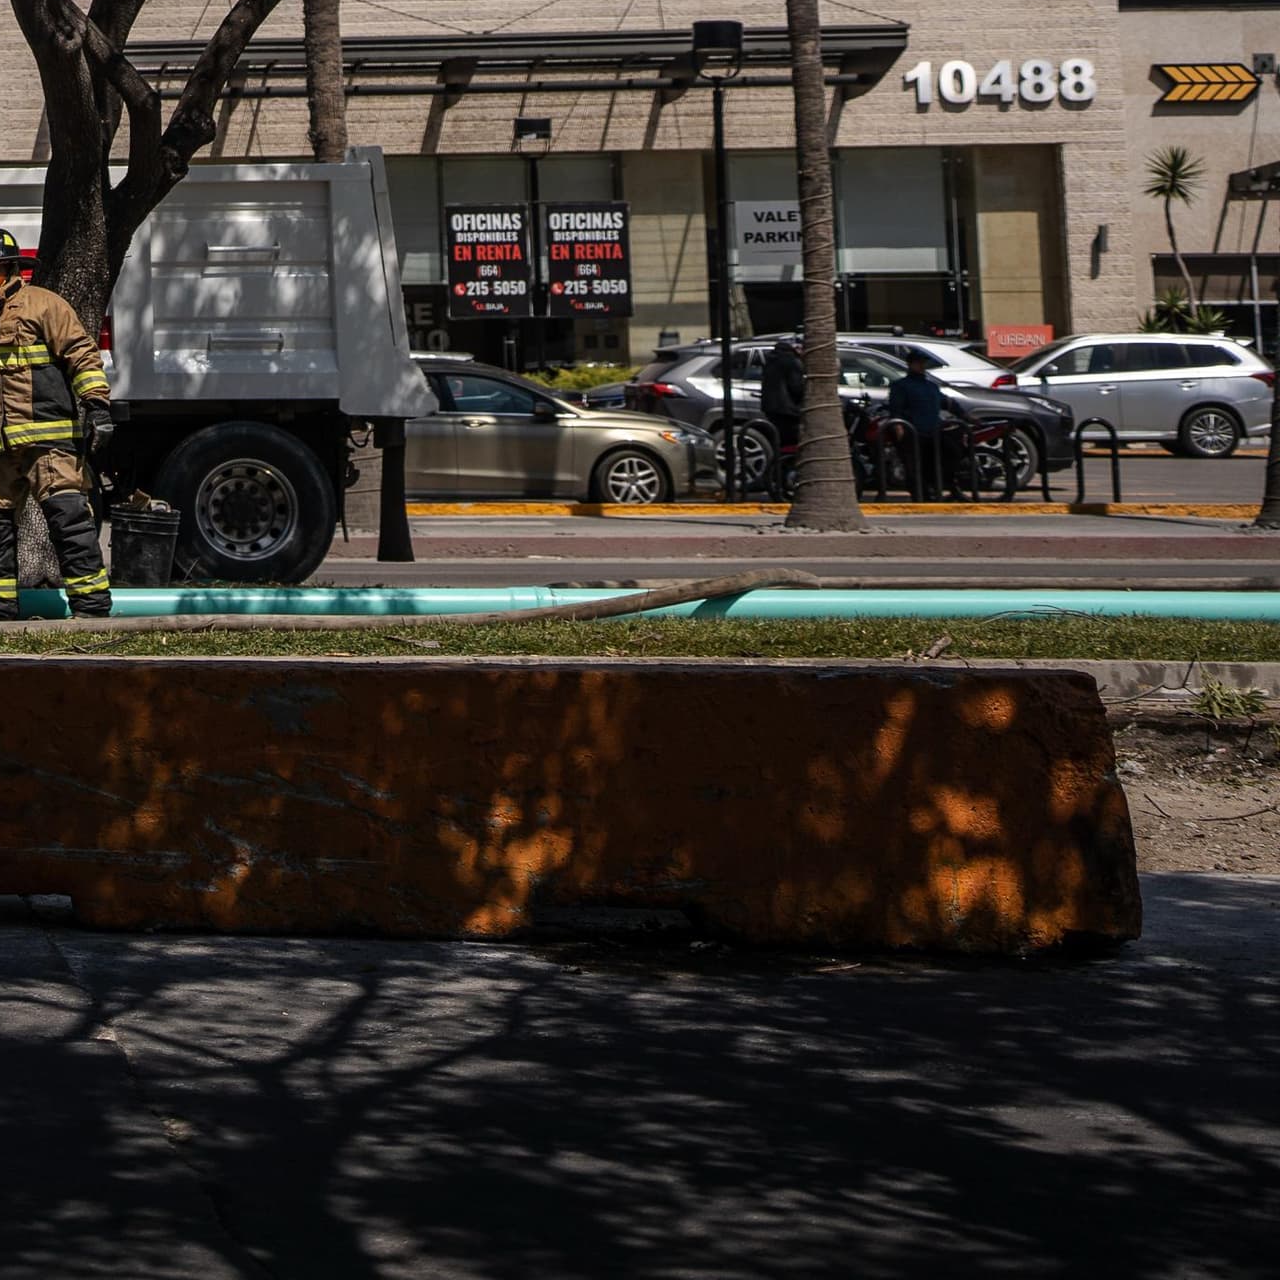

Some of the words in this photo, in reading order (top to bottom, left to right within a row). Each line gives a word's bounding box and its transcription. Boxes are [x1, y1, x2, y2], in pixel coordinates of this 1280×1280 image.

[904, 58, 1096, 104] 10488
[451, 213, 522, 231] OFICINAS
[549, 212, 624, 230] OFICINAS
[753, 210, 801, 223] VALE
[455, 232, 518, 242] DISPONIBLES
[553, 231, 619, 241] DISPONIBLES
[743, 231, 802, 244] PARKI
[454, 244, 472, 261] EN
[476, 244, 522, 261] RENTA
[551, 244, 570, 260] EN
[574, 243, 623, 260] RENTA
